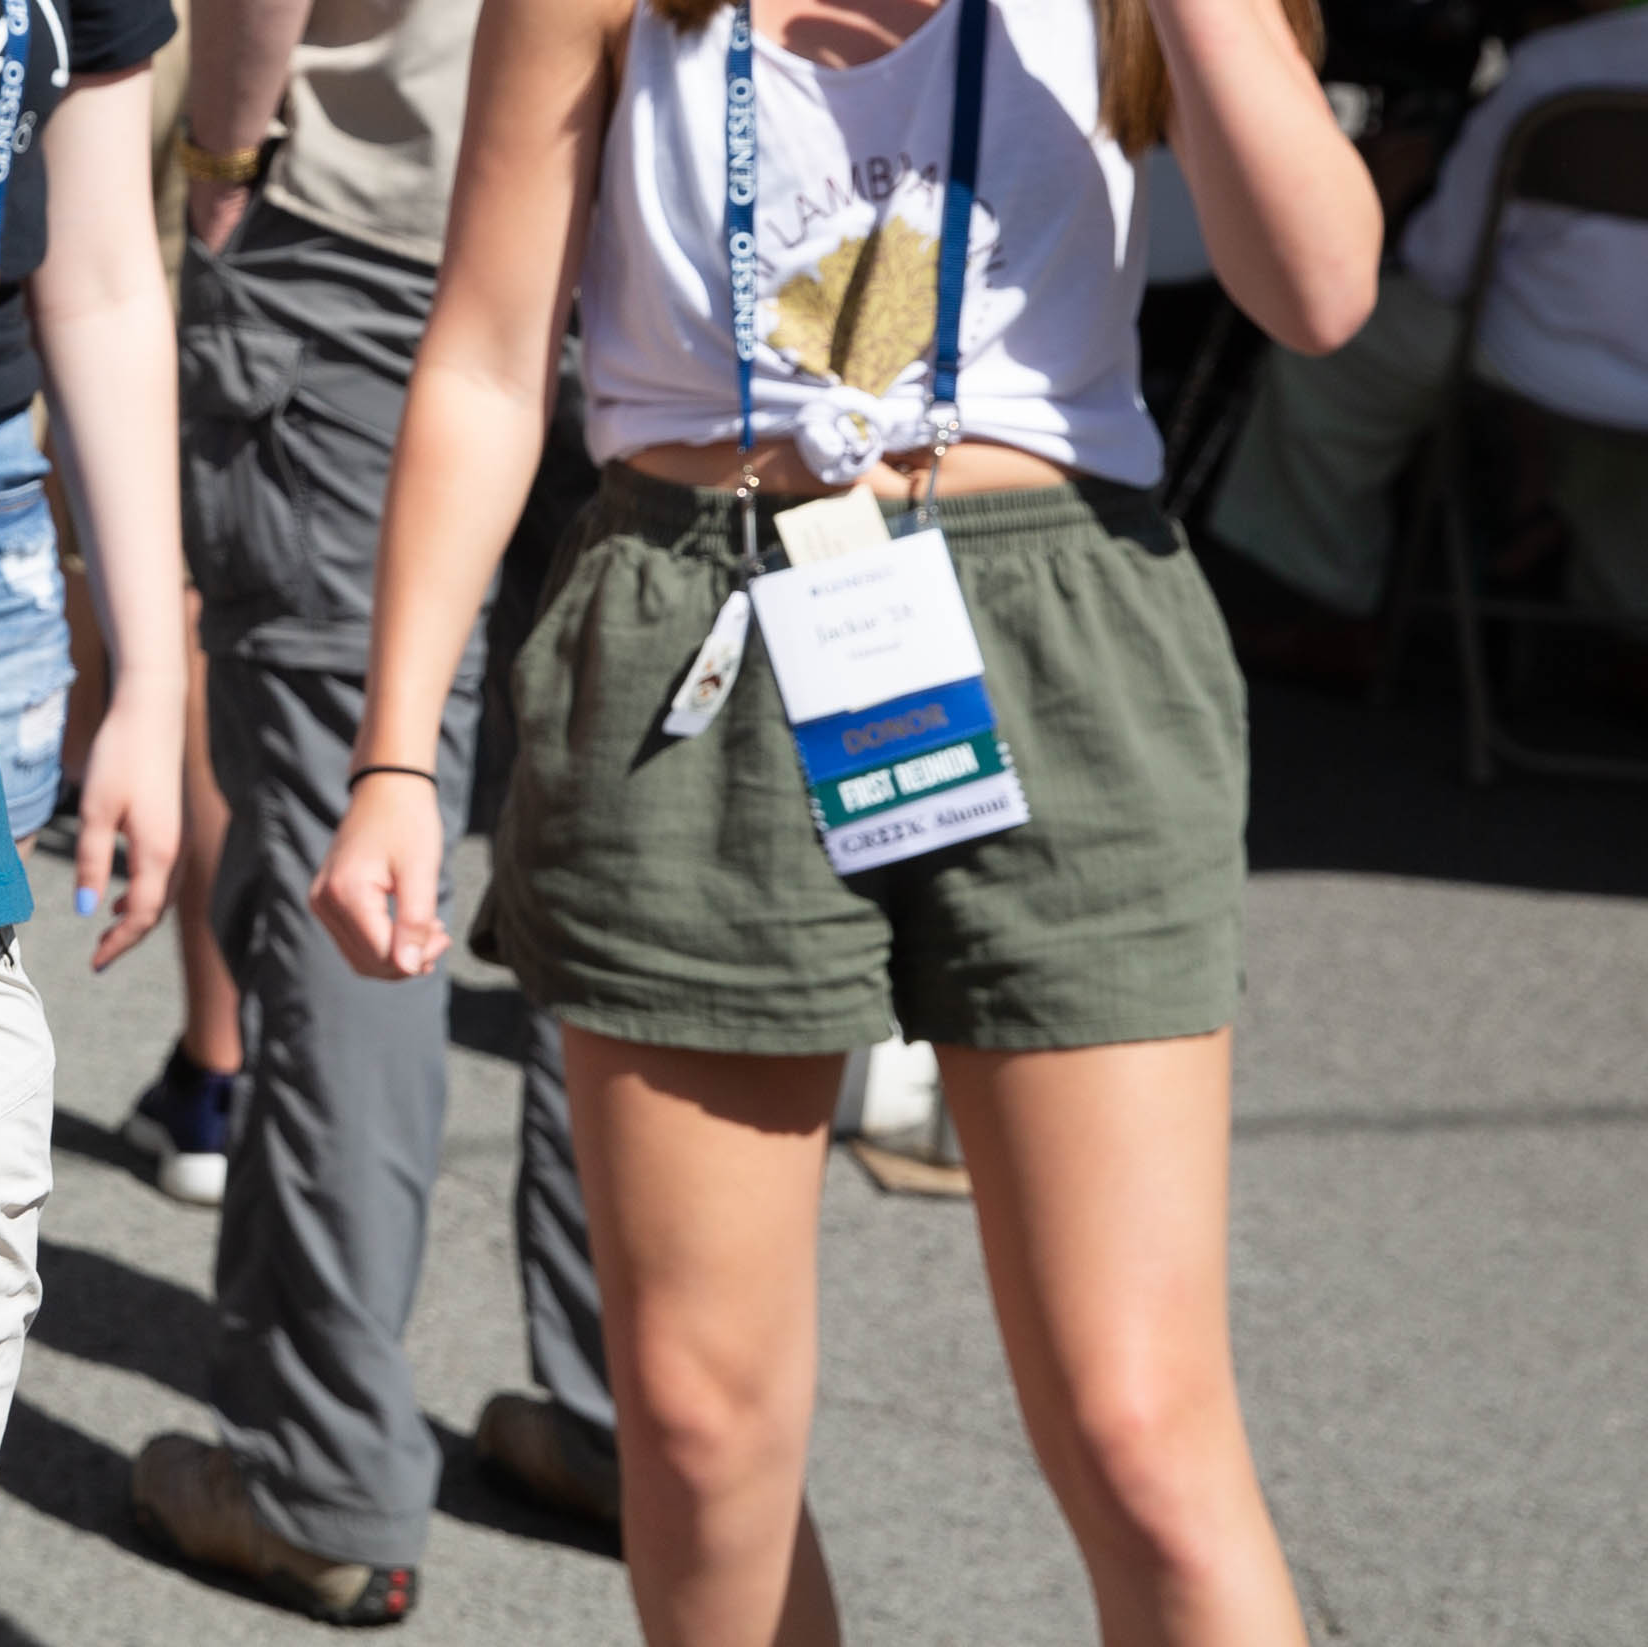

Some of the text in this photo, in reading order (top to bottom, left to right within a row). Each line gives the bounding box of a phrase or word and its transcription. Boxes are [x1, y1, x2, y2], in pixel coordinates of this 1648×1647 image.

[842, 703, 949, 756] DONOR
[837, 742, 980, 814] FIRST REUNION
[936, 794, 1011, 828] Alumni
